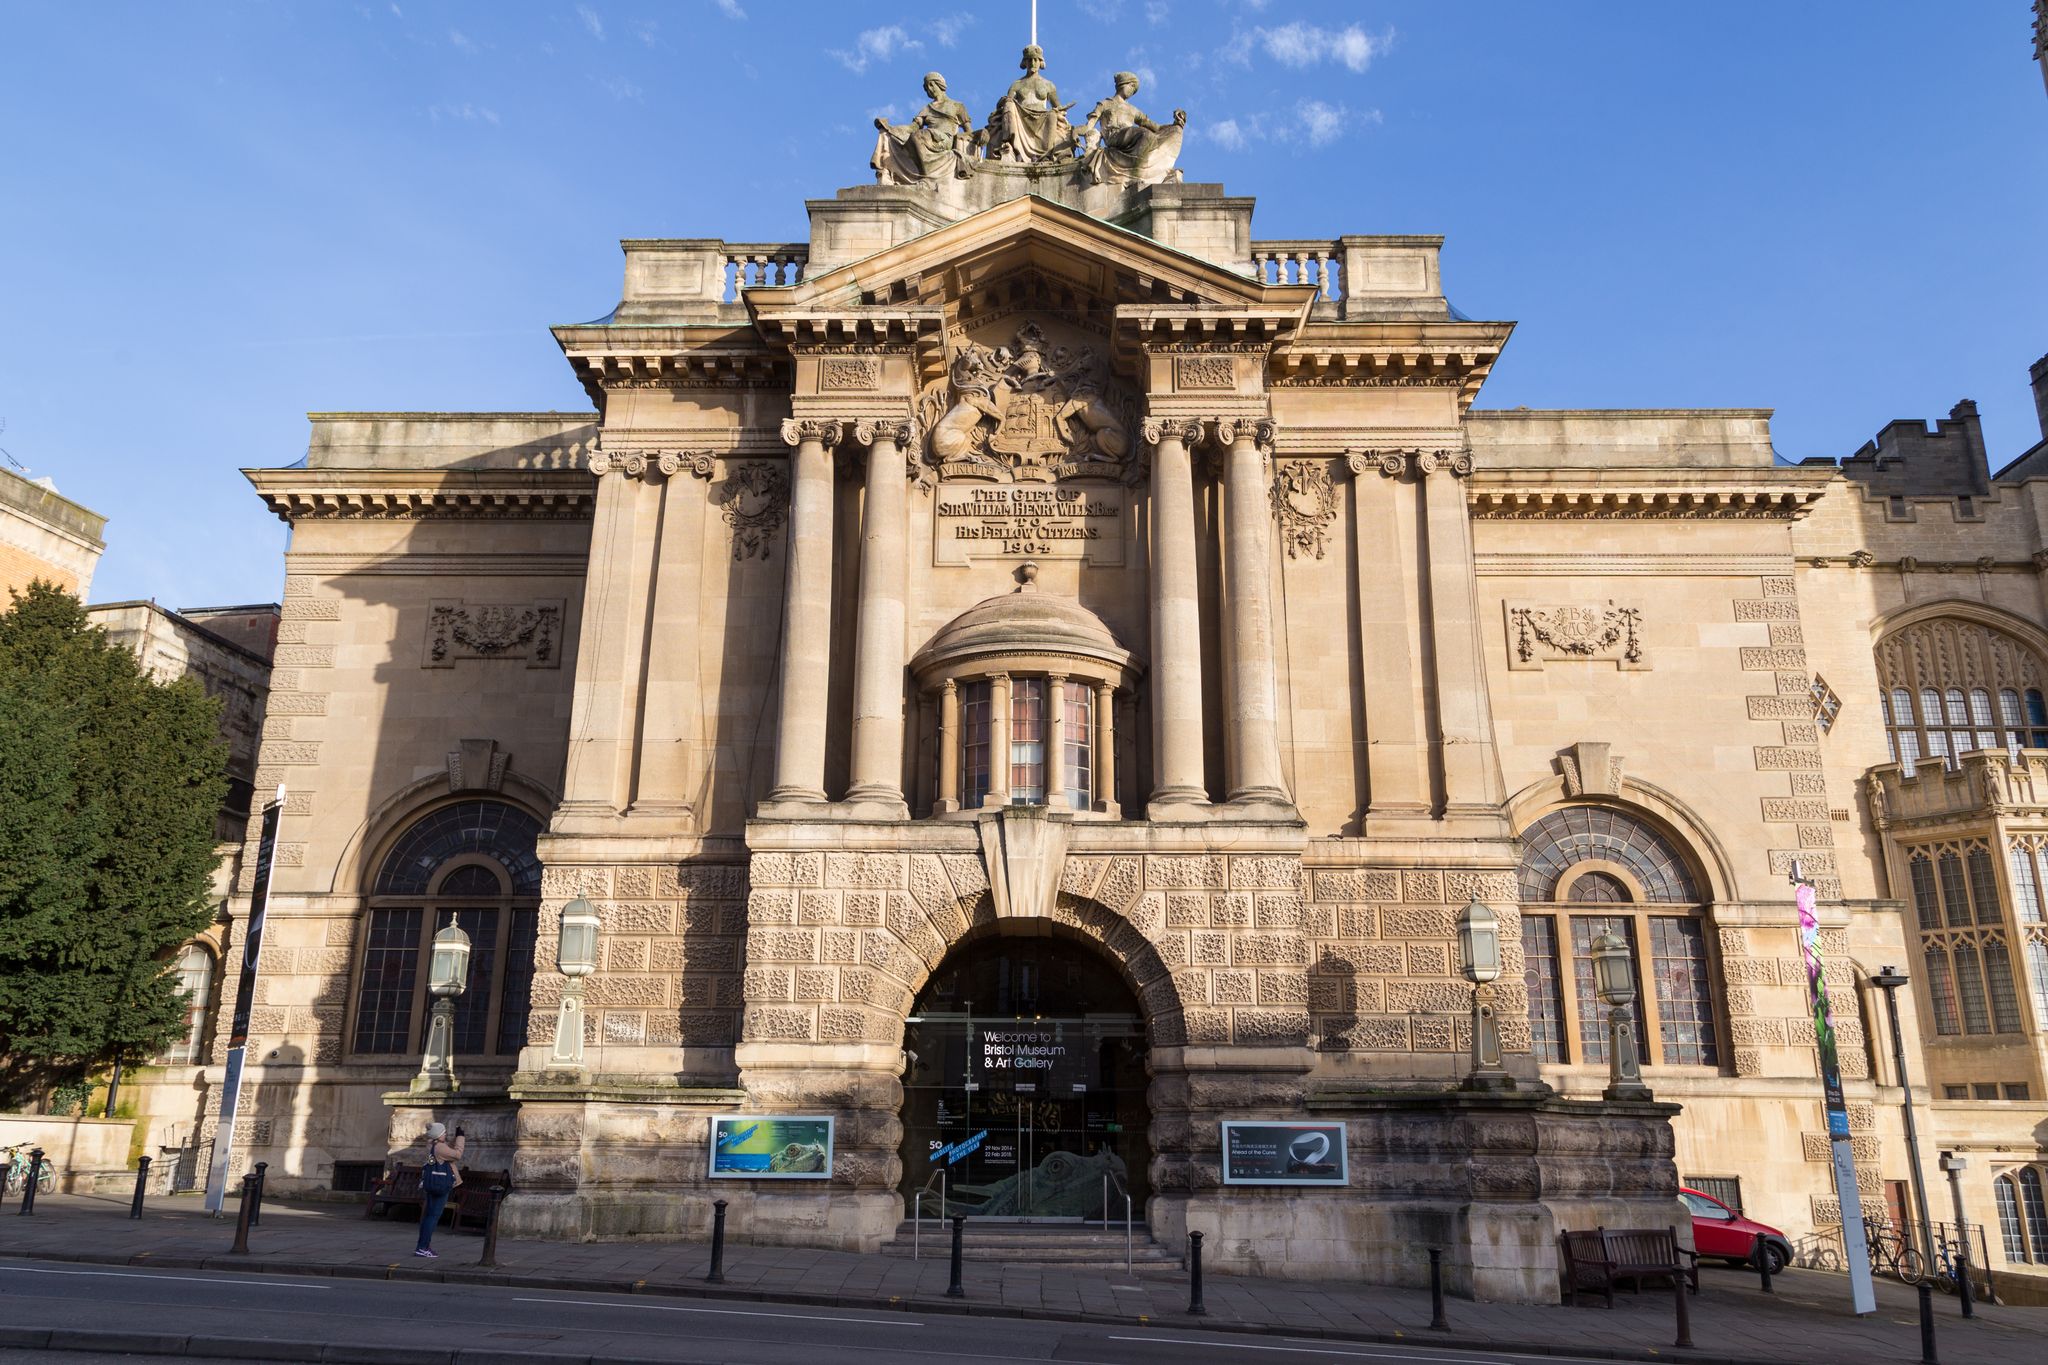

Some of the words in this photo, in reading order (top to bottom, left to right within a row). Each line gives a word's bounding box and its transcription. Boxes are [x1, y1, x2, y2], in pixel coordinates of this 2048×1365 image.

[942, 464, 995, 477] VIRTUTE
[1021, 467, 1039, 478] ET
[971, 489, 1007, 502] THE
[1011, 489, 1053, 502] GIFT
[1055, 489, 1080, 502] OF
[938, 502, 961, 517] SIR
[961, 502, 1011, 517] WILLIAM
[1013, 502, 1055, 517] HENRY
[1014, 518, 1040, 528] TO
[955, 526, 980, 539] HIS
[981, 526, 1033, 539] FELLOW
[984, 1031, 1037, 1042] Welcome
[1040, 1032, 1051, 1042] to
[984, 1044, 1014, 1055] Bristol
[1017, 1045, 1066, 1055] Museum
[984, 1057, 993, 1068] &
[995, 1057, 1011, 1068] Art
[1014, 1057, 1053, 1070] Gallery
[929, 1141, 942, 1149] 50
